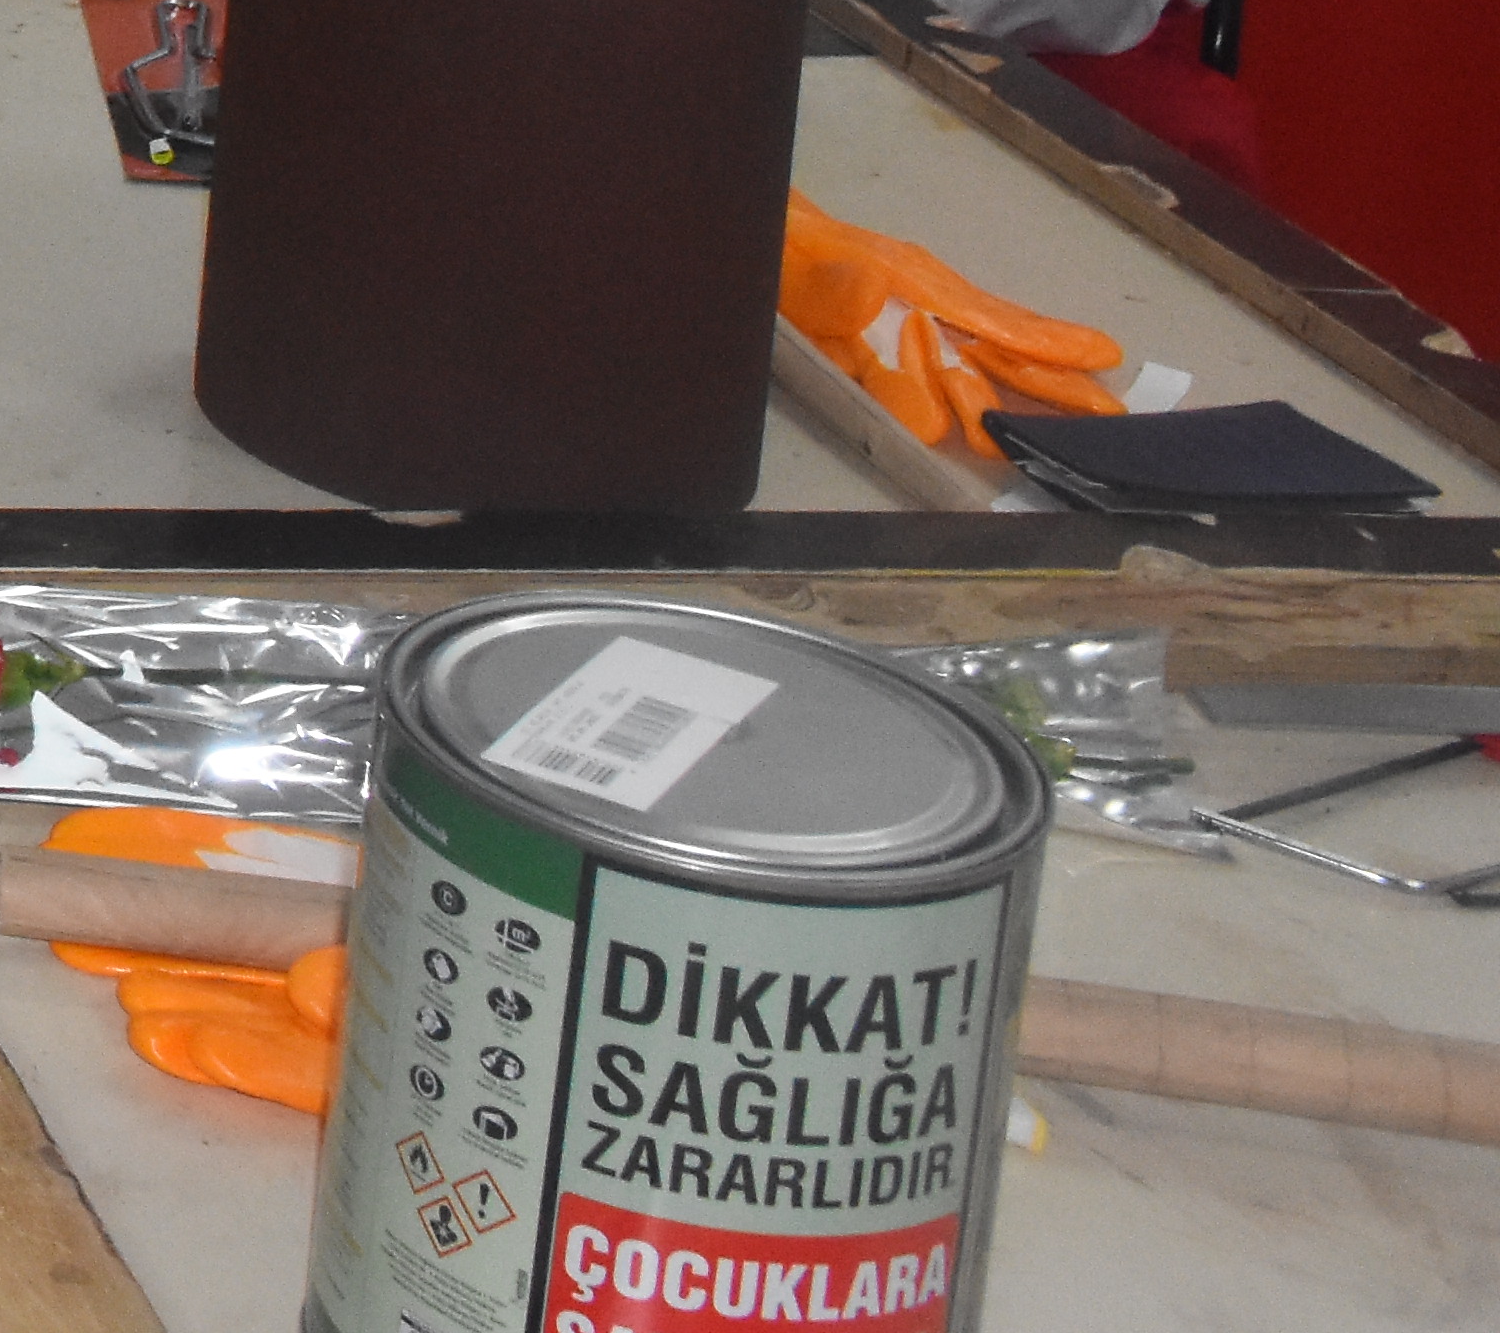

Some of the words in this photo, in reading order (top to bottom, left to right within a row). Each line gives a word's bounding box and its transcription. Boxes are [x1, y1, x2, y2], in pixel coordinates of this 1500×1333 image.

[600, 939, 979, 1055] DİKKAT!
[591, 1043, 958, 1148] SAĞLIĞA
[563, 1223, 948, 1323] ÇOCUKLARA
